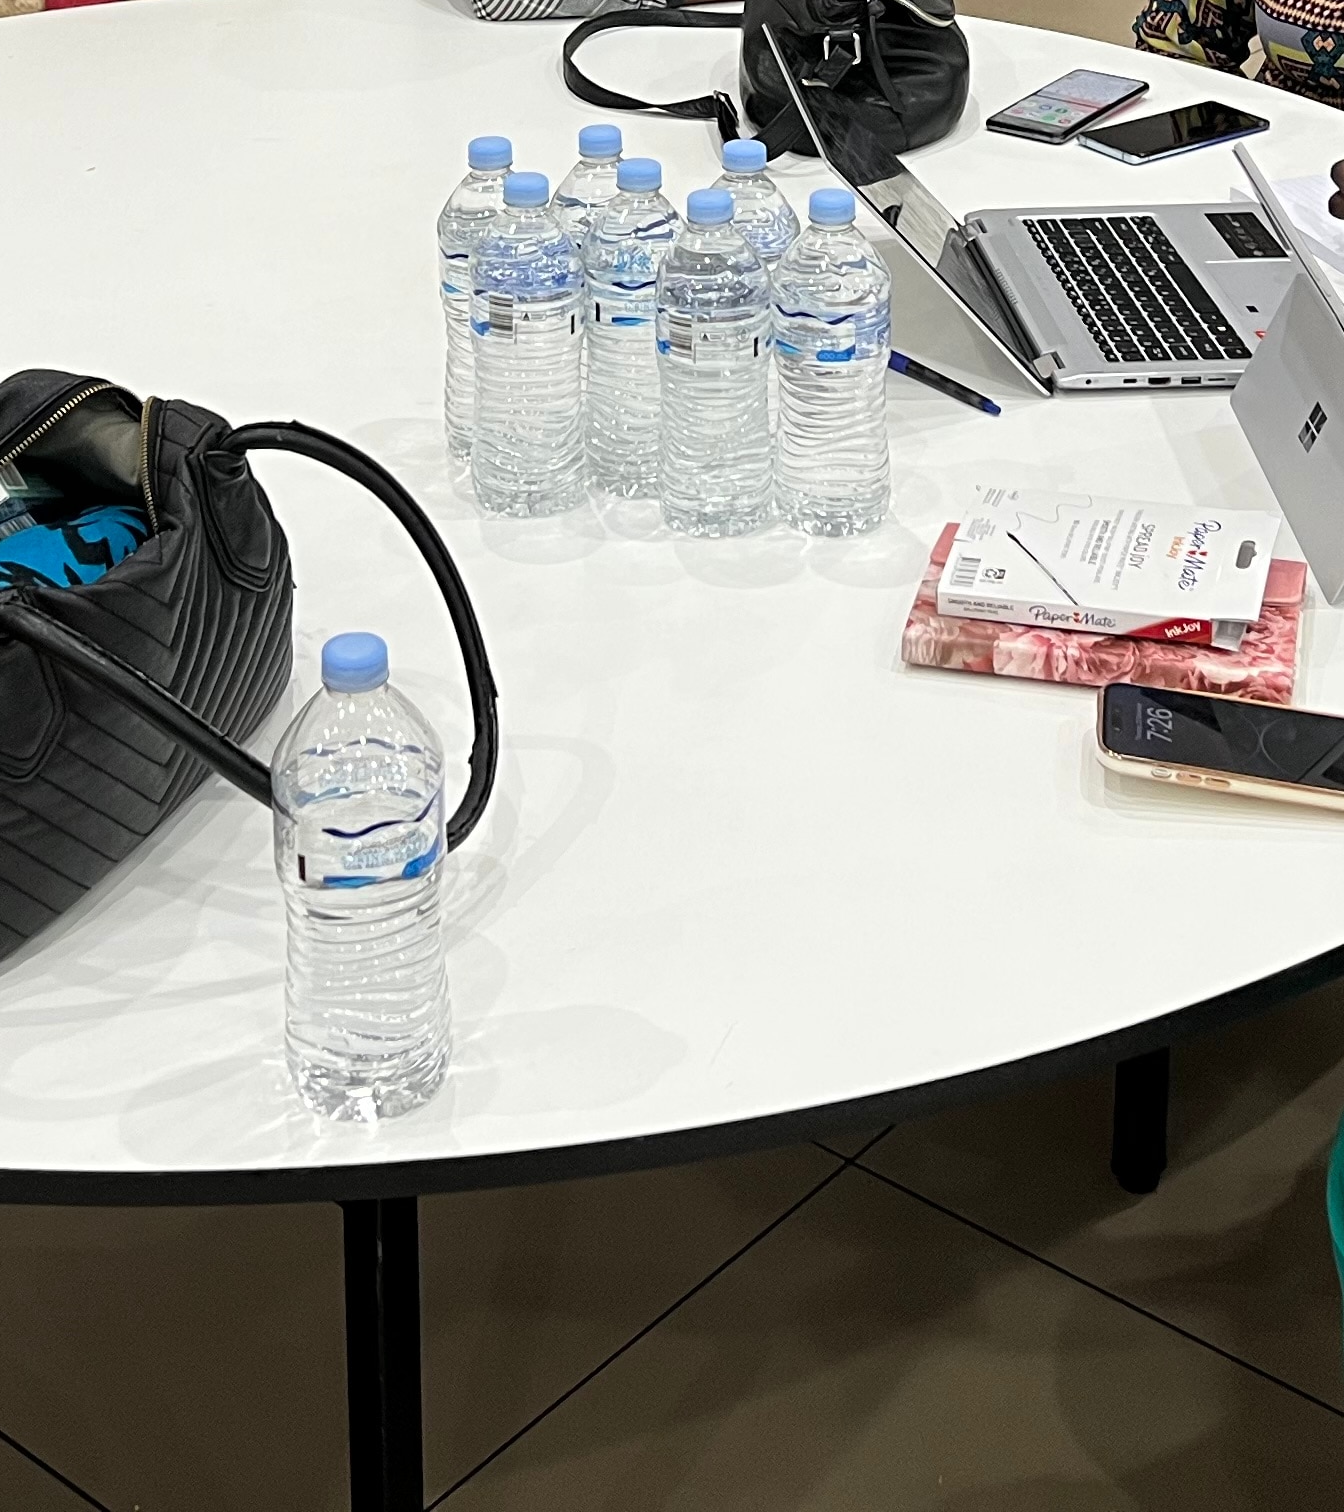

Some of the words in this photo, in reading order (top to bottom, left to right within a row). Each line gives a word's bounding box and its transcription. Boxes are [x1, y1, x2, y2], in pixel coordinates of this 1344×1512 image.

[1132, 523, 1156, 553] SPREAD
[1187, 519, 1222, 550] Paper
[1177, 553, 1207, 591] Mate
[1029, 605, 1073, 624] Paper
[1080, 612, 1116, 628] Mate
[1164, 621, 1201, 638] InkJoy
[1146, 707, 1173, 743] 7:26
